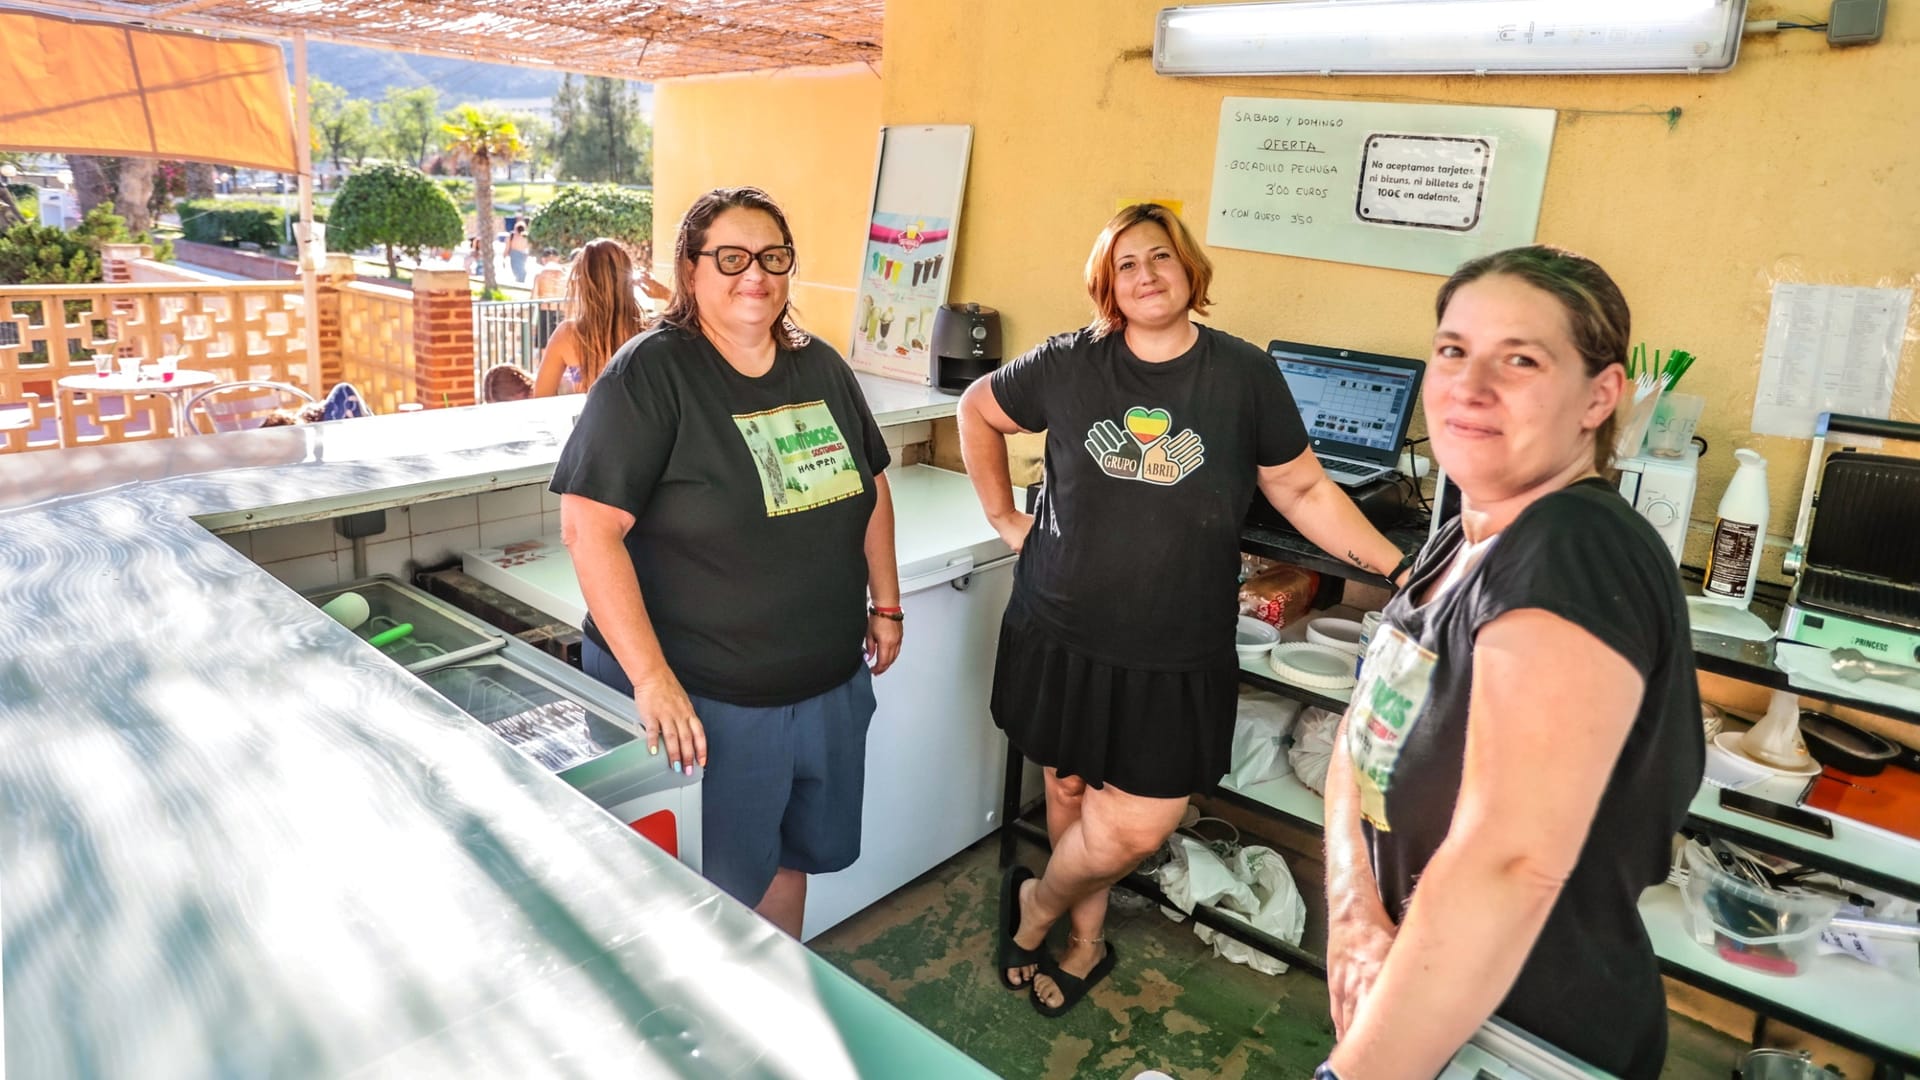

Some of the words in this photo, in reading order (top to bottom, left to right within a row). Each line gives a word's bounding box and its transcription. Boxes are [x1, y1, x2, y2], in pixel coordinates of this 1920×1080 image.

[1235, 110, 1280, 123] SABADO
[1286, 117, 1292, 126] Y
[1297, 118, 1344, 127] DOMINGO
[1263, 139, 1316, 152] OFERTA
[1290, 163, 1338, 174] PECHUGA
[1371, 161, 1383, 169] No
[1386, 162, 1435, 173] aceptamos
[1369, 174, 1378, 183] ni
[1414, 177, 1423, 186] ni
[1425, 178, 1459, 189] billetes
[1462, 181, 1474, 189] de
[1296, 187, 1329, 198] EUROS
[1378, 188, 1401, 198] 100€
[1231, 208, 1249, 218] CON
[1254, 211, 1280, 222] QUESO
[1104, 455, 1137, 472] GRUPO
[1145, 463, 1175, 478] ABRIL
[1855, 637, 1889, 652] PRINCESS
